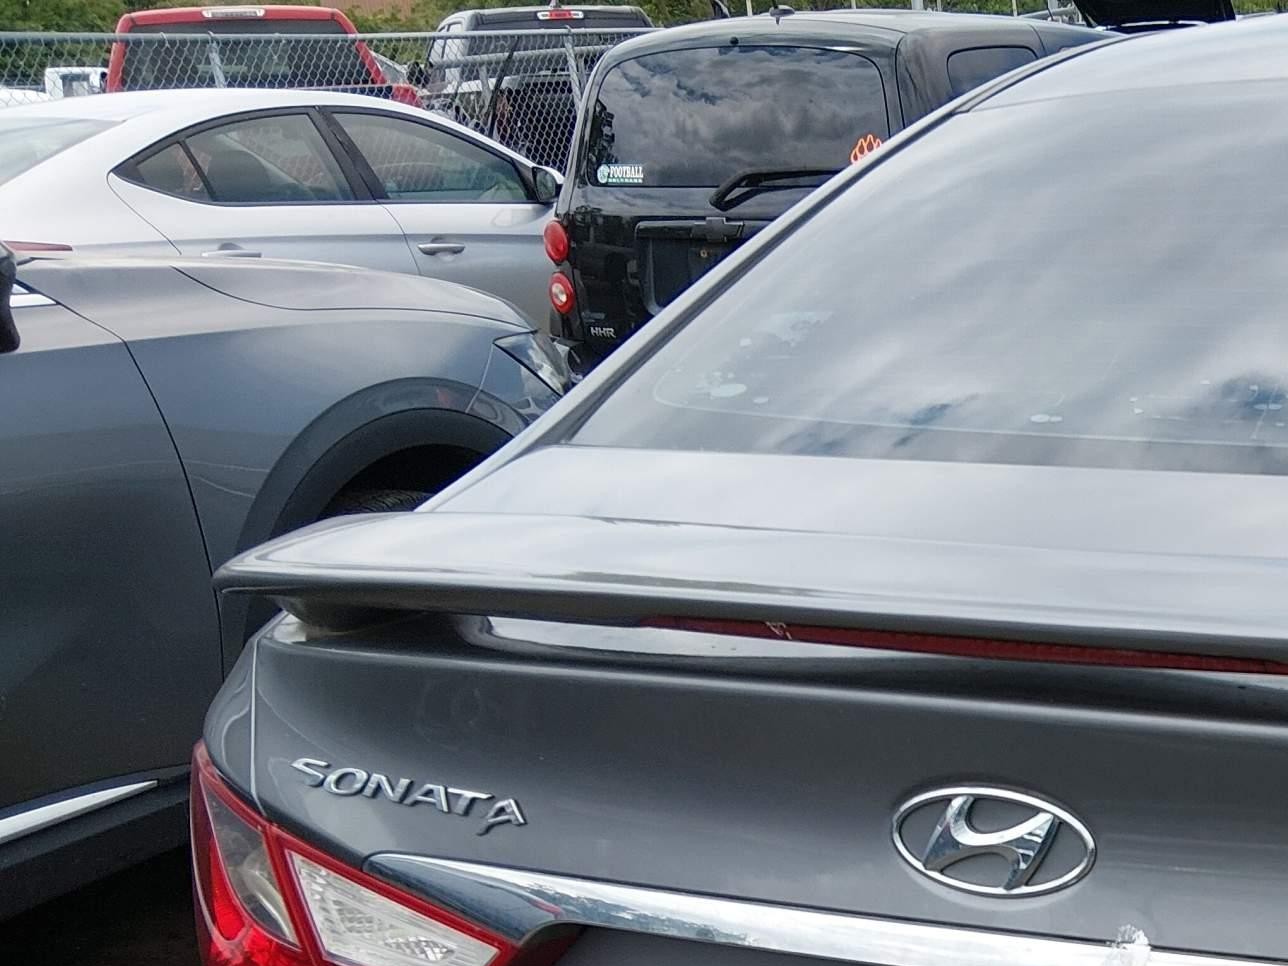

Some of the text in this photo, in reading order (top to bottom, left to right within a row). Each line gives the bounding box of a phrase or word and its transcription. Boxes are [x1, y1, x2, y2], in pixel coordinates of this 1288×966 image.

[609, 166, 644, 178] FOOTBALL
[590, 326, 617, 338] HHR
[291, 757, 527, 836] SONATA
